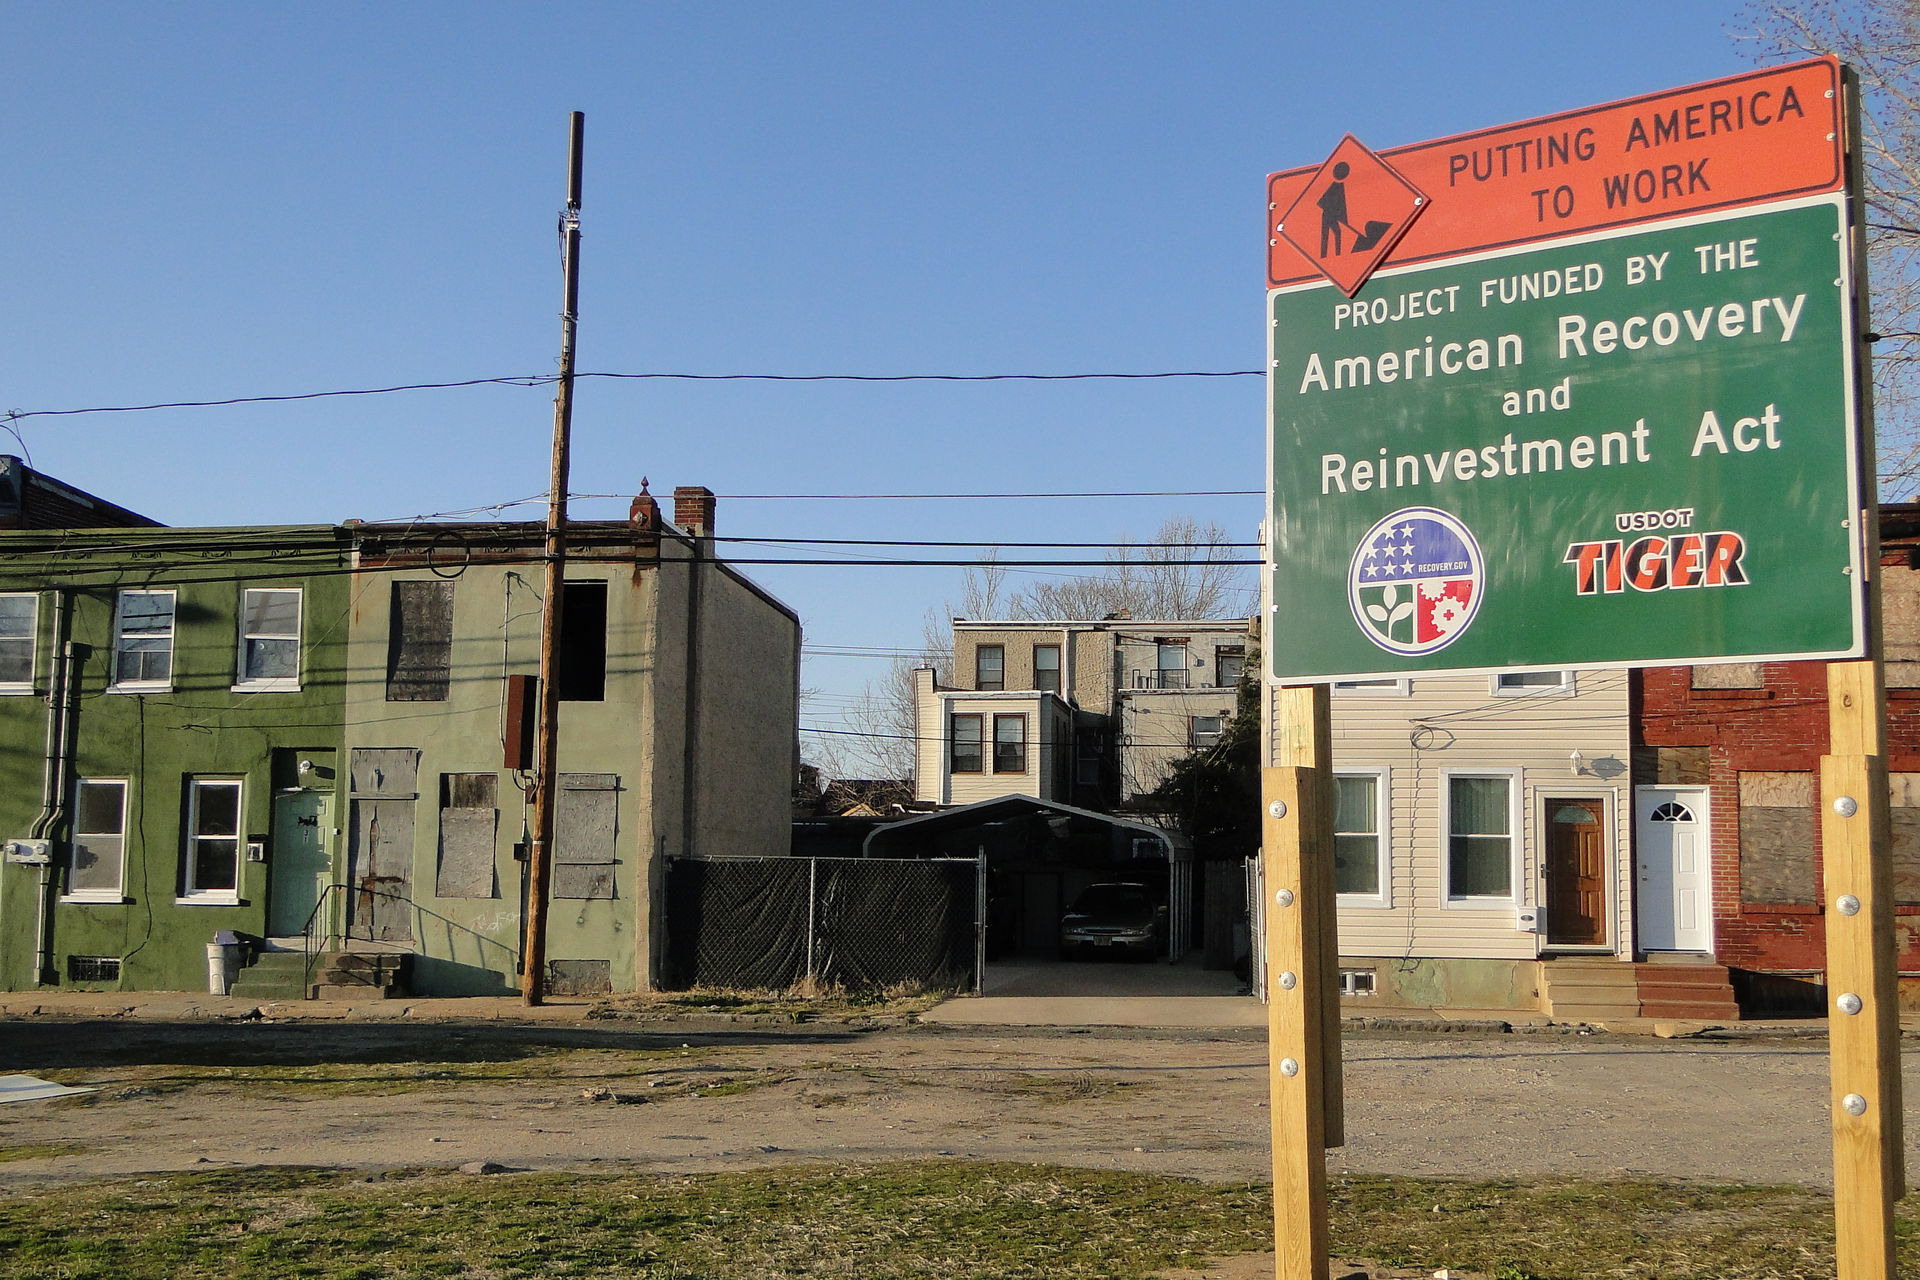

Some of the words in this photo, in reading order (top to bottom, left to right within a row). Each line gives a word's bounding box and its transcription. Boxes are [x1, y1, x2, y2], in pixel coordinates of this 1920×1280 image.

[1449, 127, 1596, 186] PUTTING
[1625, 86, 1804, 151] AMERICA
[1532, 186, 1575, 222] TO
[1605, 158, 1711, 209] WORK
[1334, 286, 1460, 329] PROJECT
[1481, 263, 1604, 307] FUNDED
[1626, 252, 1670, 284] BY
[1694, 238, 1759, 274] THE
[1300, 332, 1523, 394] American
[1558, 293, 1807, 359] Recovery
[1502, 376, 1571, 416] and
[1321, 418, 1651, 494] Reinvestment
[1691, 403, 1781, 457] Act
[1616, 508, 1694, 532] USDOT
[1418, 560, 1468, 573] RECOVERY.GOV
[1563, 531, 1750, 595] TIGER
